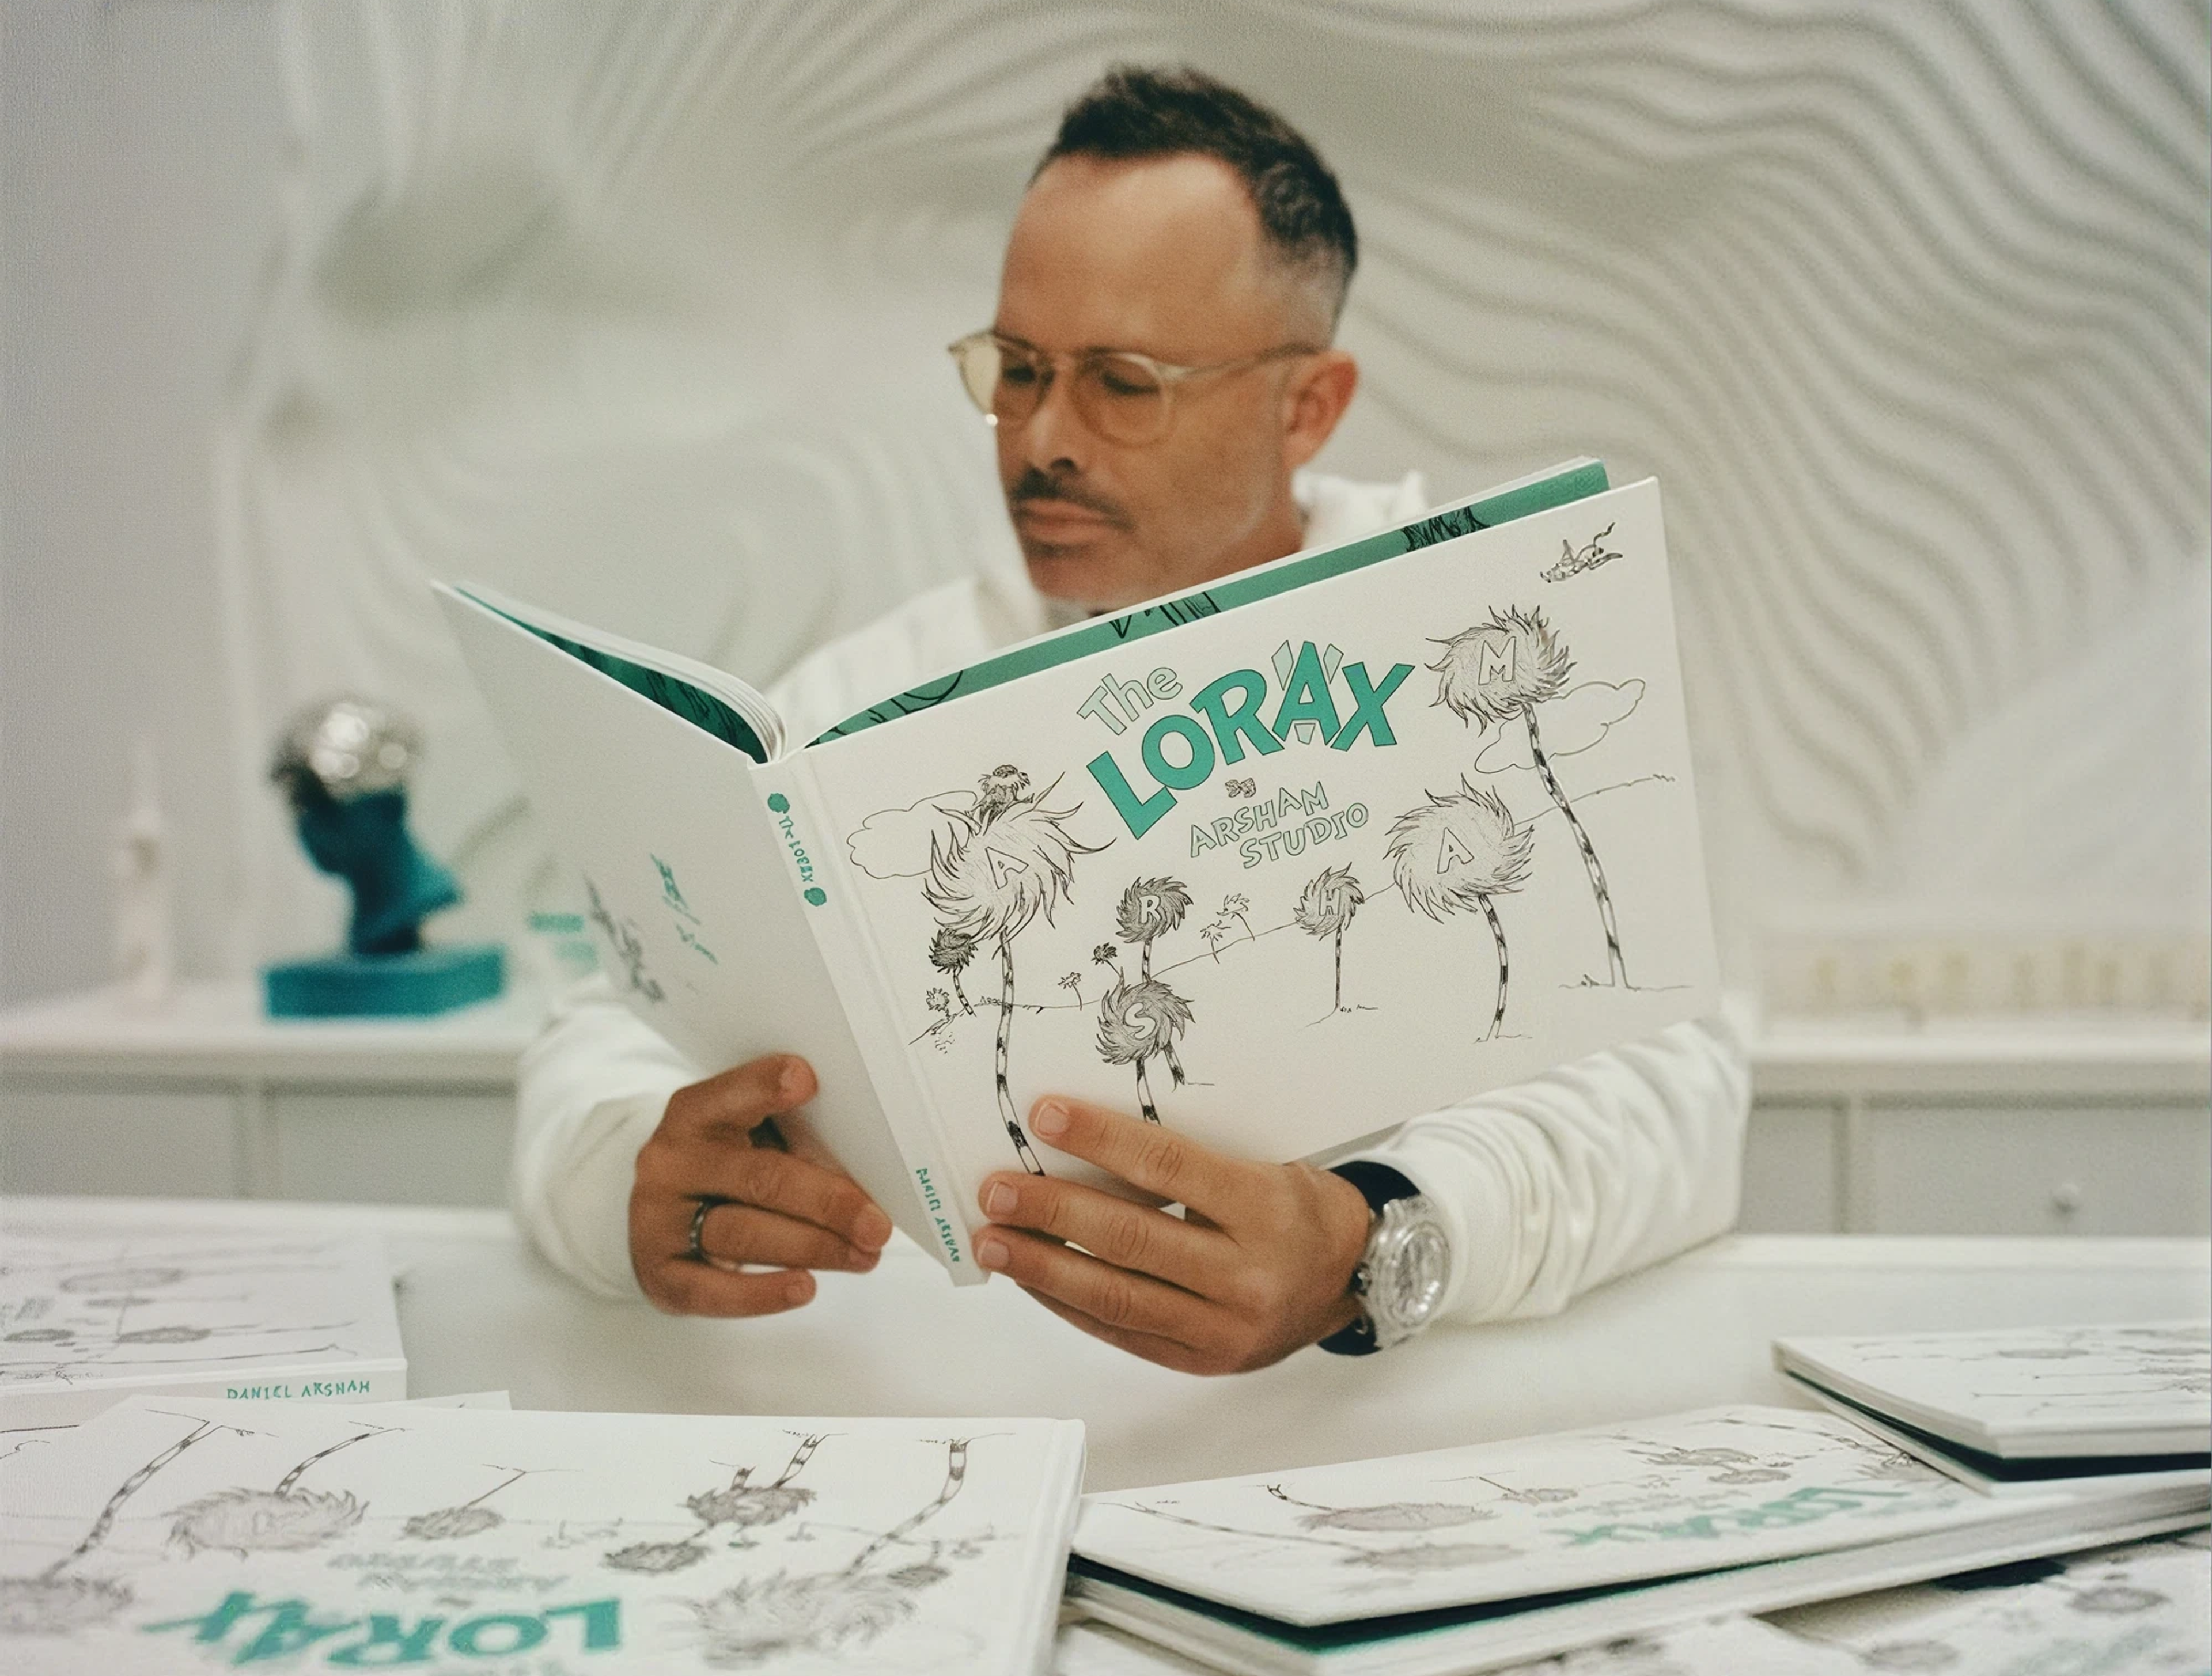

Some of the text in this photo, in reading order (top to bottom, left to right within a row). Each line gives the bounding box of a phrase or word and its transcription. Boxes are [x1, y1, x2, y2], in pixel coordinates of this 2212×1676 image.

[1478, 636, 1516, 685] M
[1077, 667, 1183, 736] The
[1086, 640, 1415, 840] LORAX
[1190, 780, 1330, 858] ARSHAM
[1239, 802, 1369, 869] STUDIO
[985, 846, 1029, 889] A
[1437, 827, 1474, 874] A
[1141, 894, 1163, 926] R
[1319, 887, 1341, 916] H
[1124, 1002, 1158, 1041] S
[227, 1385, 292, 1400] DANIEL
[139, 1590, 621, 1668] LORAX
